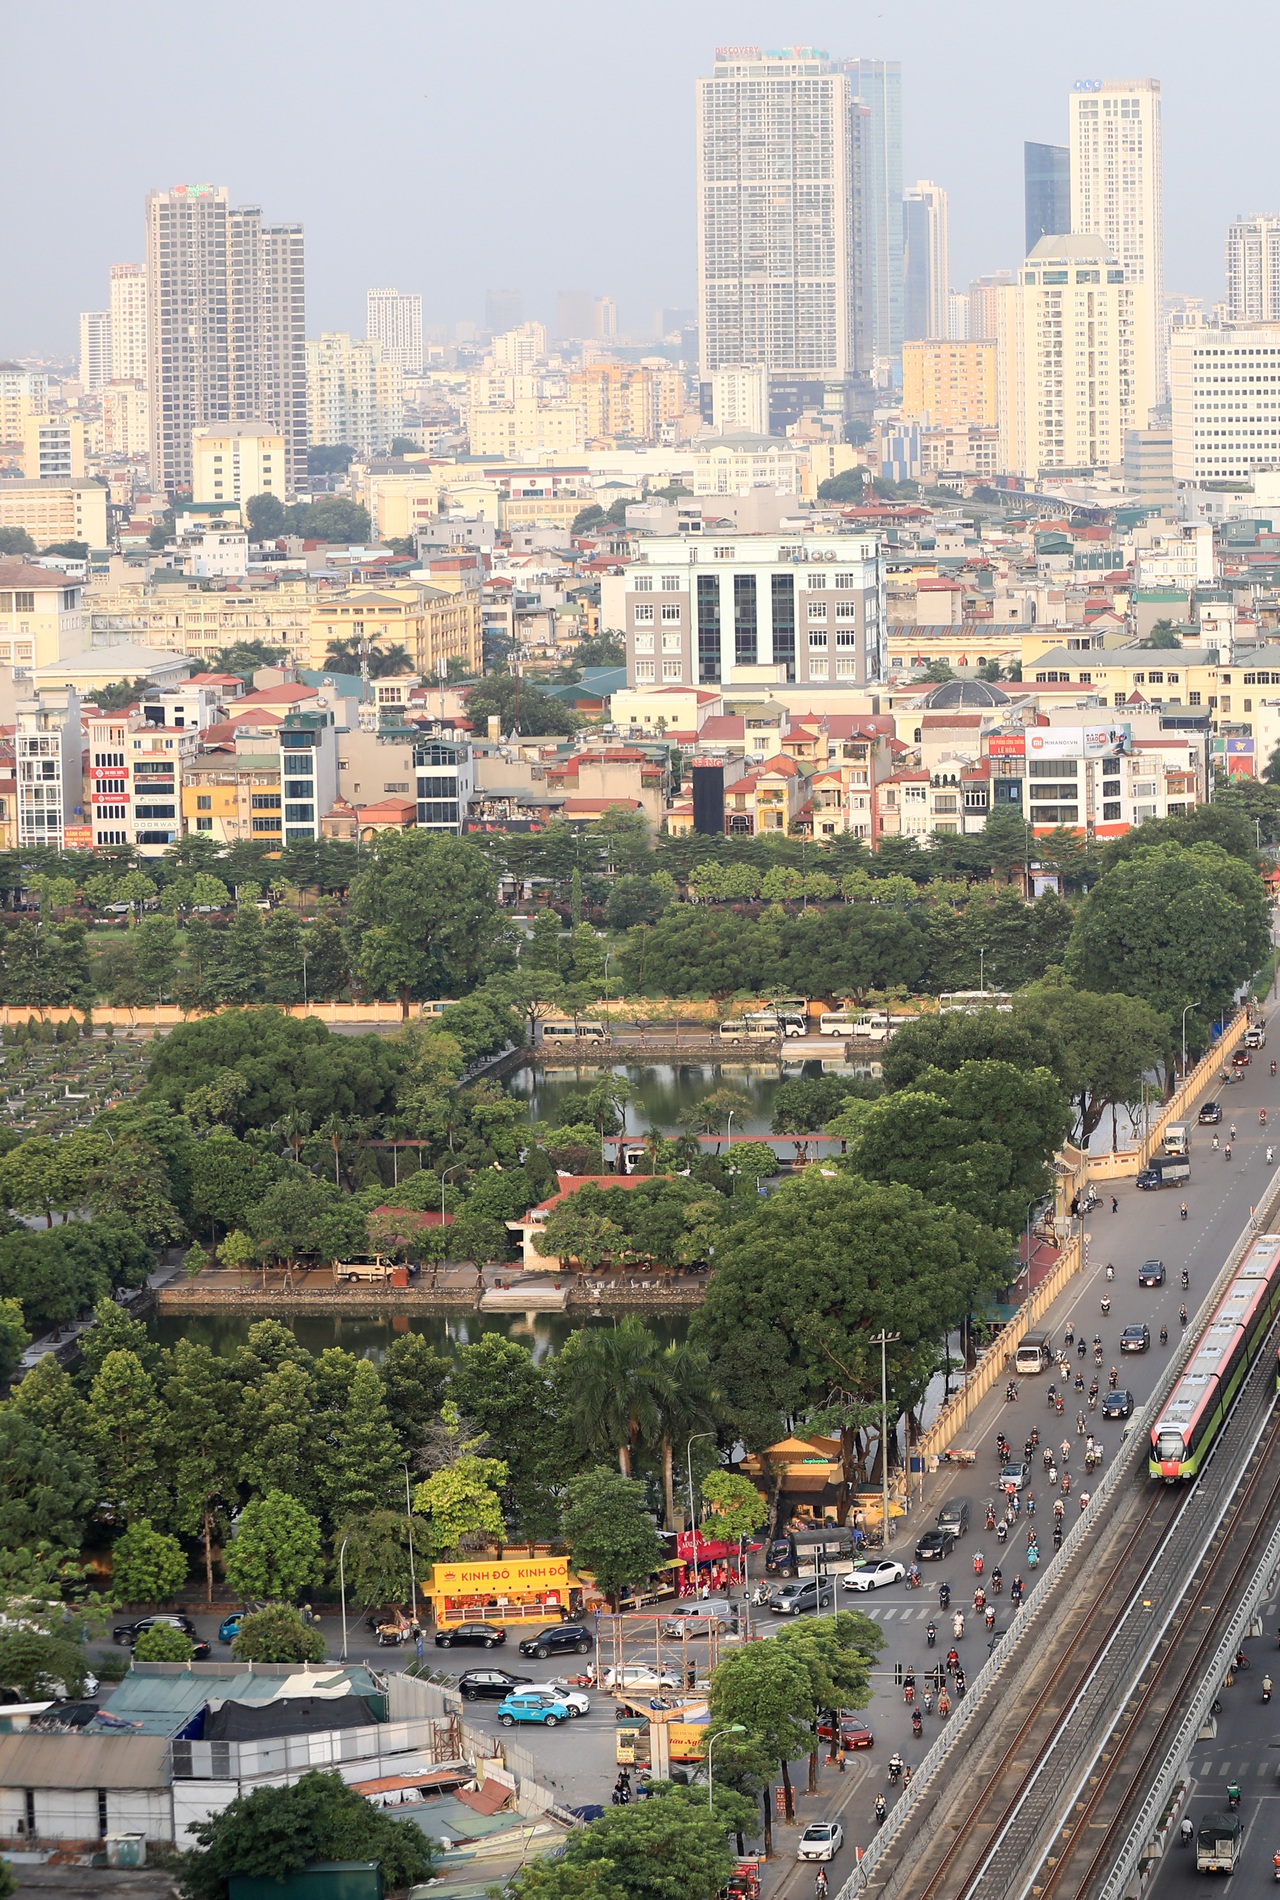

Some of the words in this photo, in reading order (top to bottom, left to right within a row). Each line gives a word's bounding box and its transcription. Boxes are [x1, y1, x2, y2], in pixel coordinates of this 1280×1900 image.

[715, 46, 758, 55] DISCOVERY
[461, 1571, 489, 1581] KINH
[492, 1568, 510, 1580] ĐÔ
[518, 1568, 546, 1578] KINH
[548, 1564, 567, 1576] ĐÔ
